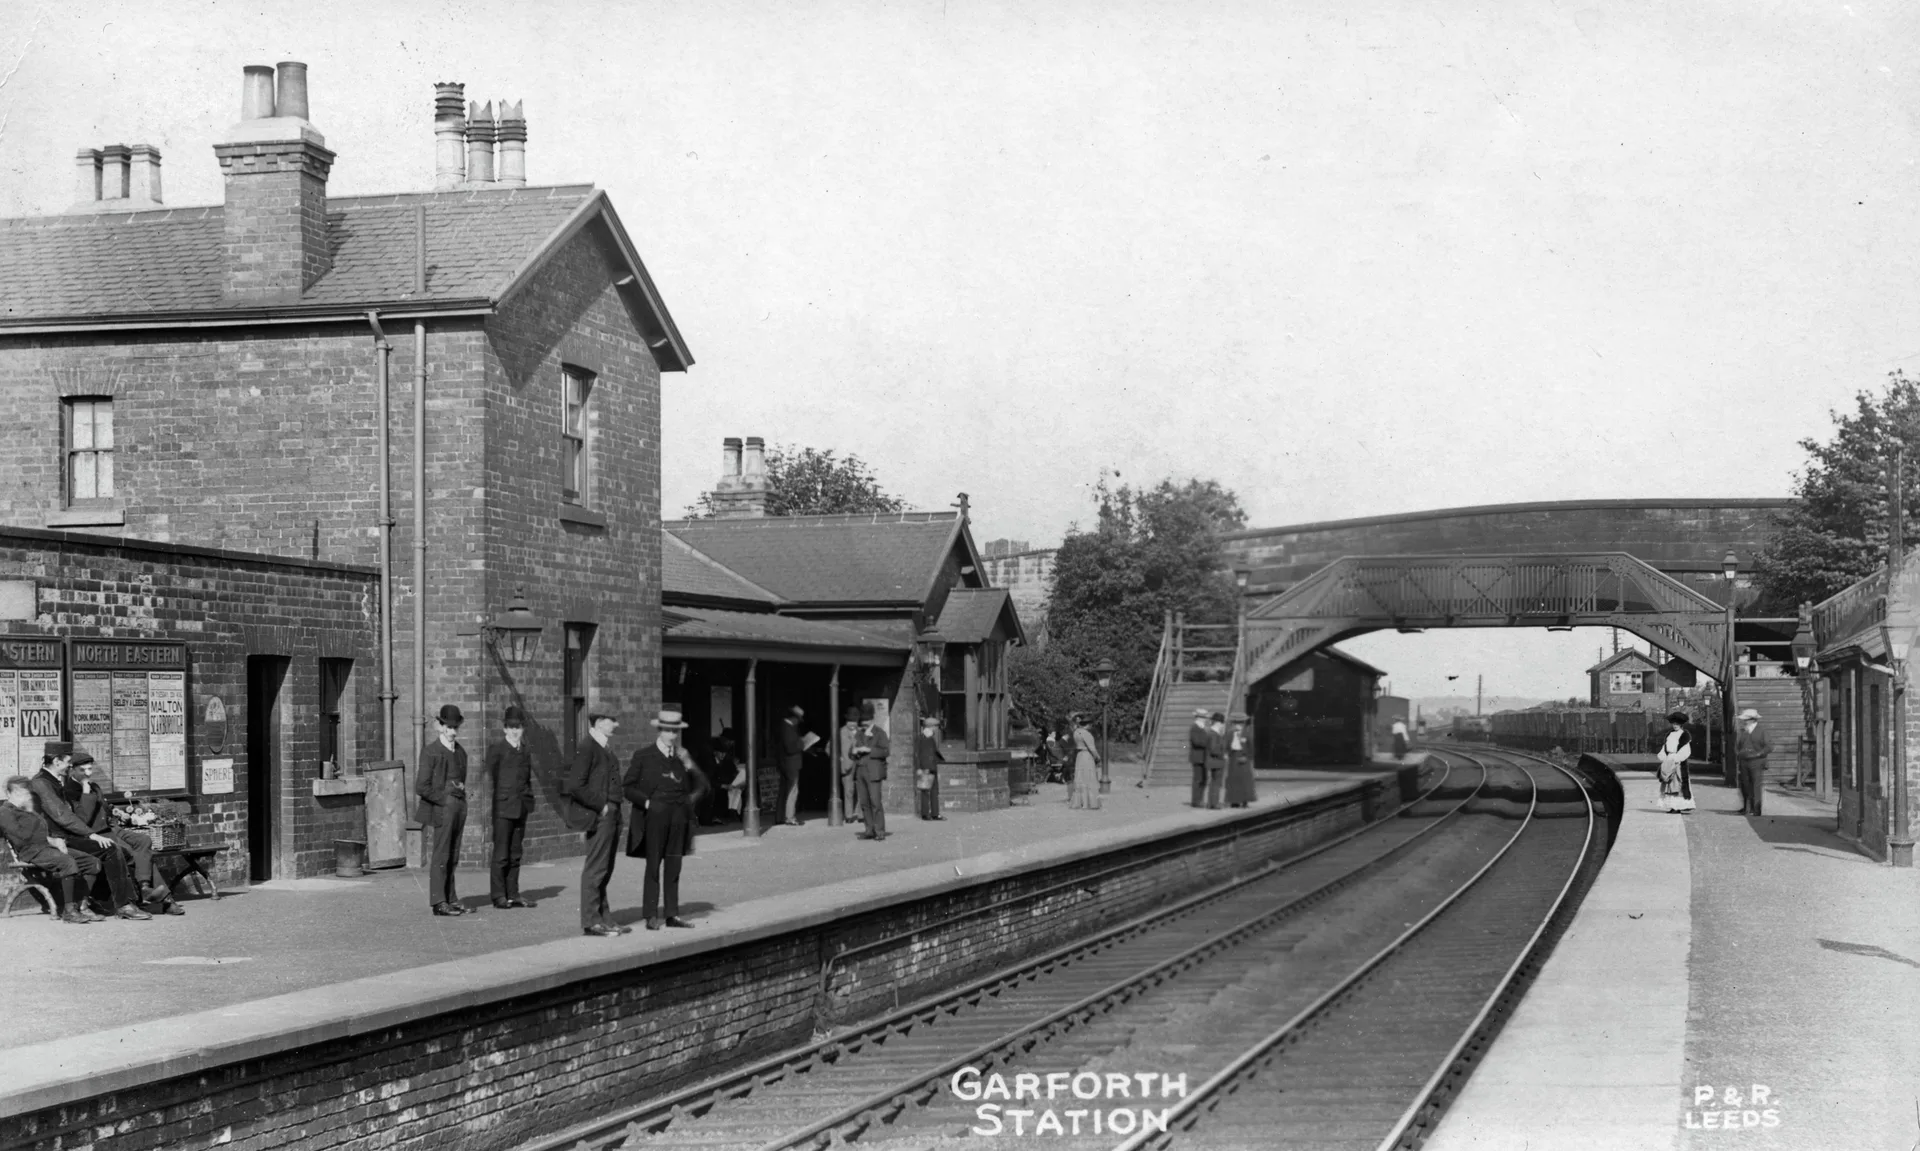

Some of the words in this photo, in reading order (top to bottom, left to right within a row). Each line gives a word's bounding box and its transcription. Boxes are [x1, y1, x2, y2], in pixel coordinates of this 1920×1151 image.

[76, 645, 119, 662] NORTH
[125, 645, 181, 663] EASTERN
[150, 700, 183, 713] MALTON
[21, 709, 59, 736] YORK
[204, 767, 233, 782] SPHERE
